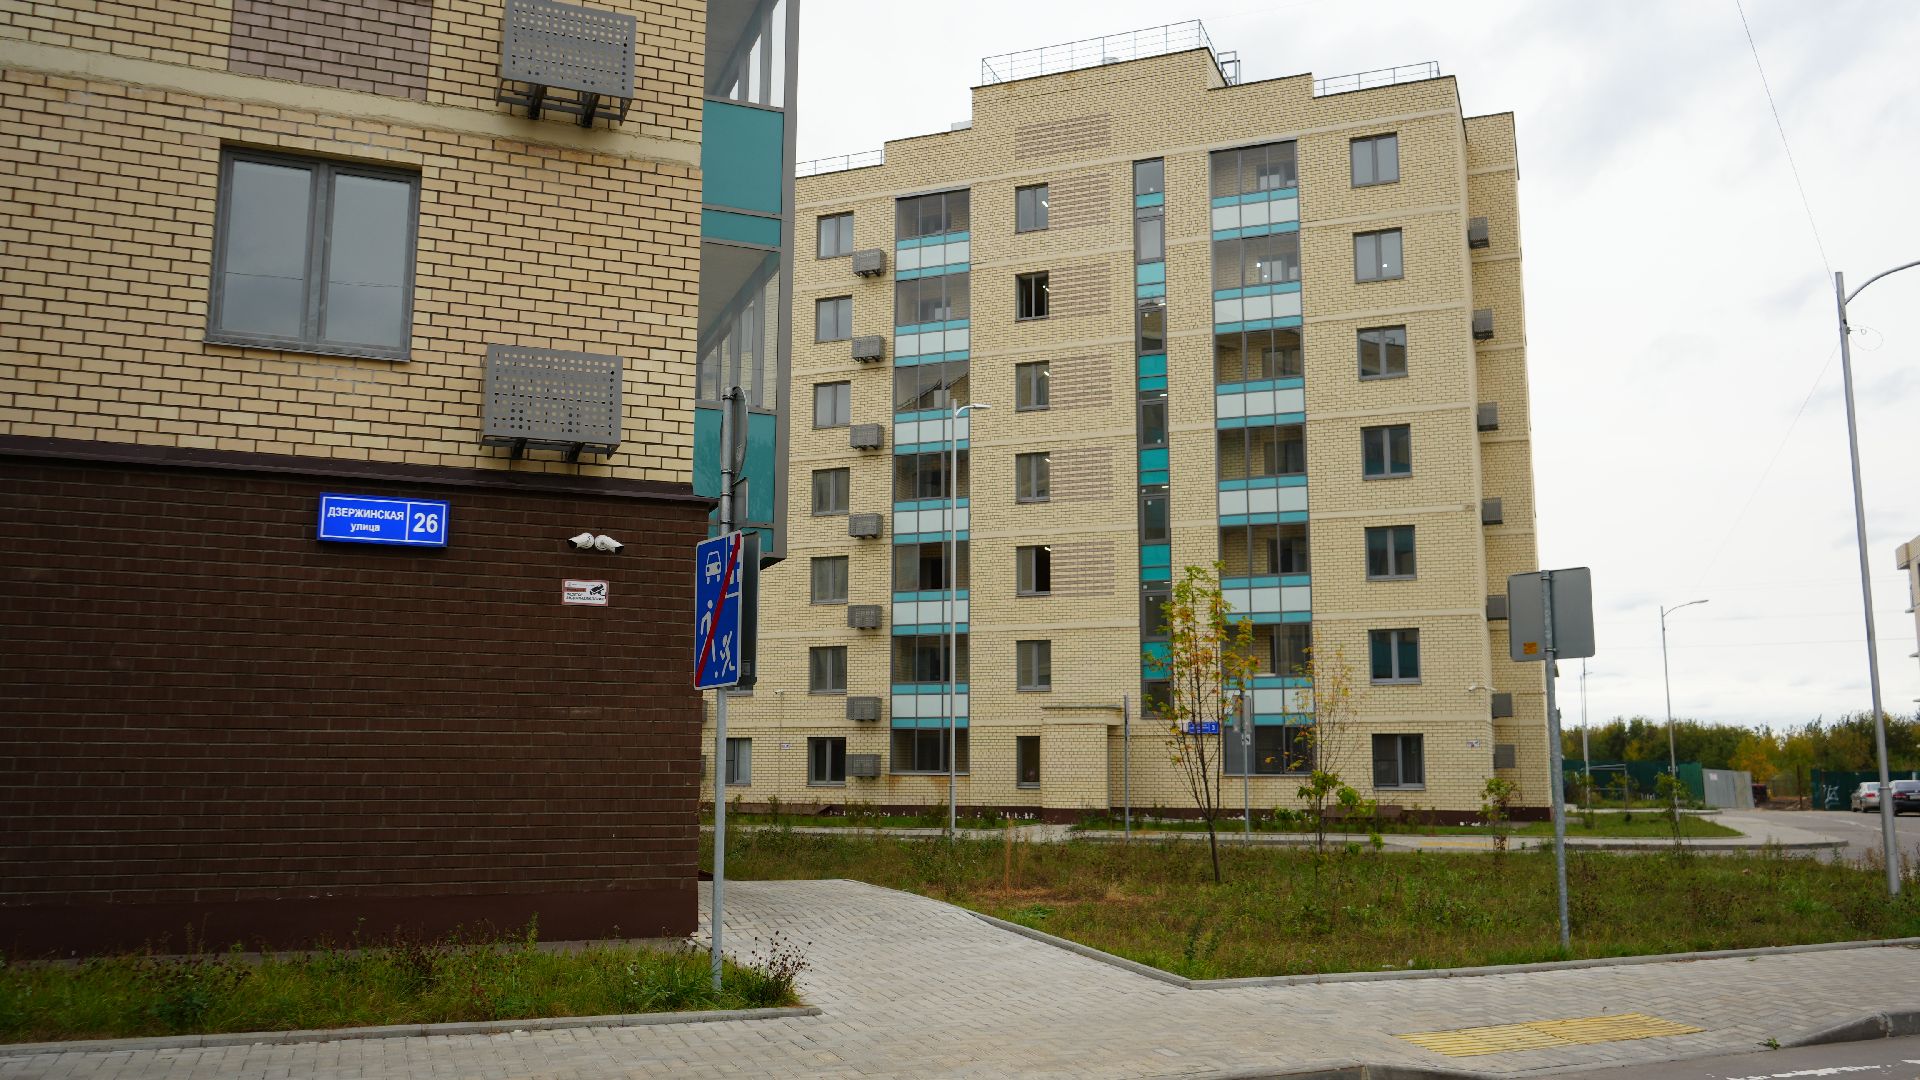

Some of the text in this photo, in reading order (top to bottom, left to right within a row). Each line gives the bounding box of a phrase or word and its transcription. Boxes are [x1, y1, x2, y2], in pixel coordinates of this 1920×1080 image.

[327, 507, 404, 520] ДЗЕРЖИНСКАЯ
[350, 523, 380, 532] улица
[413, 513, 438, 533] 26
